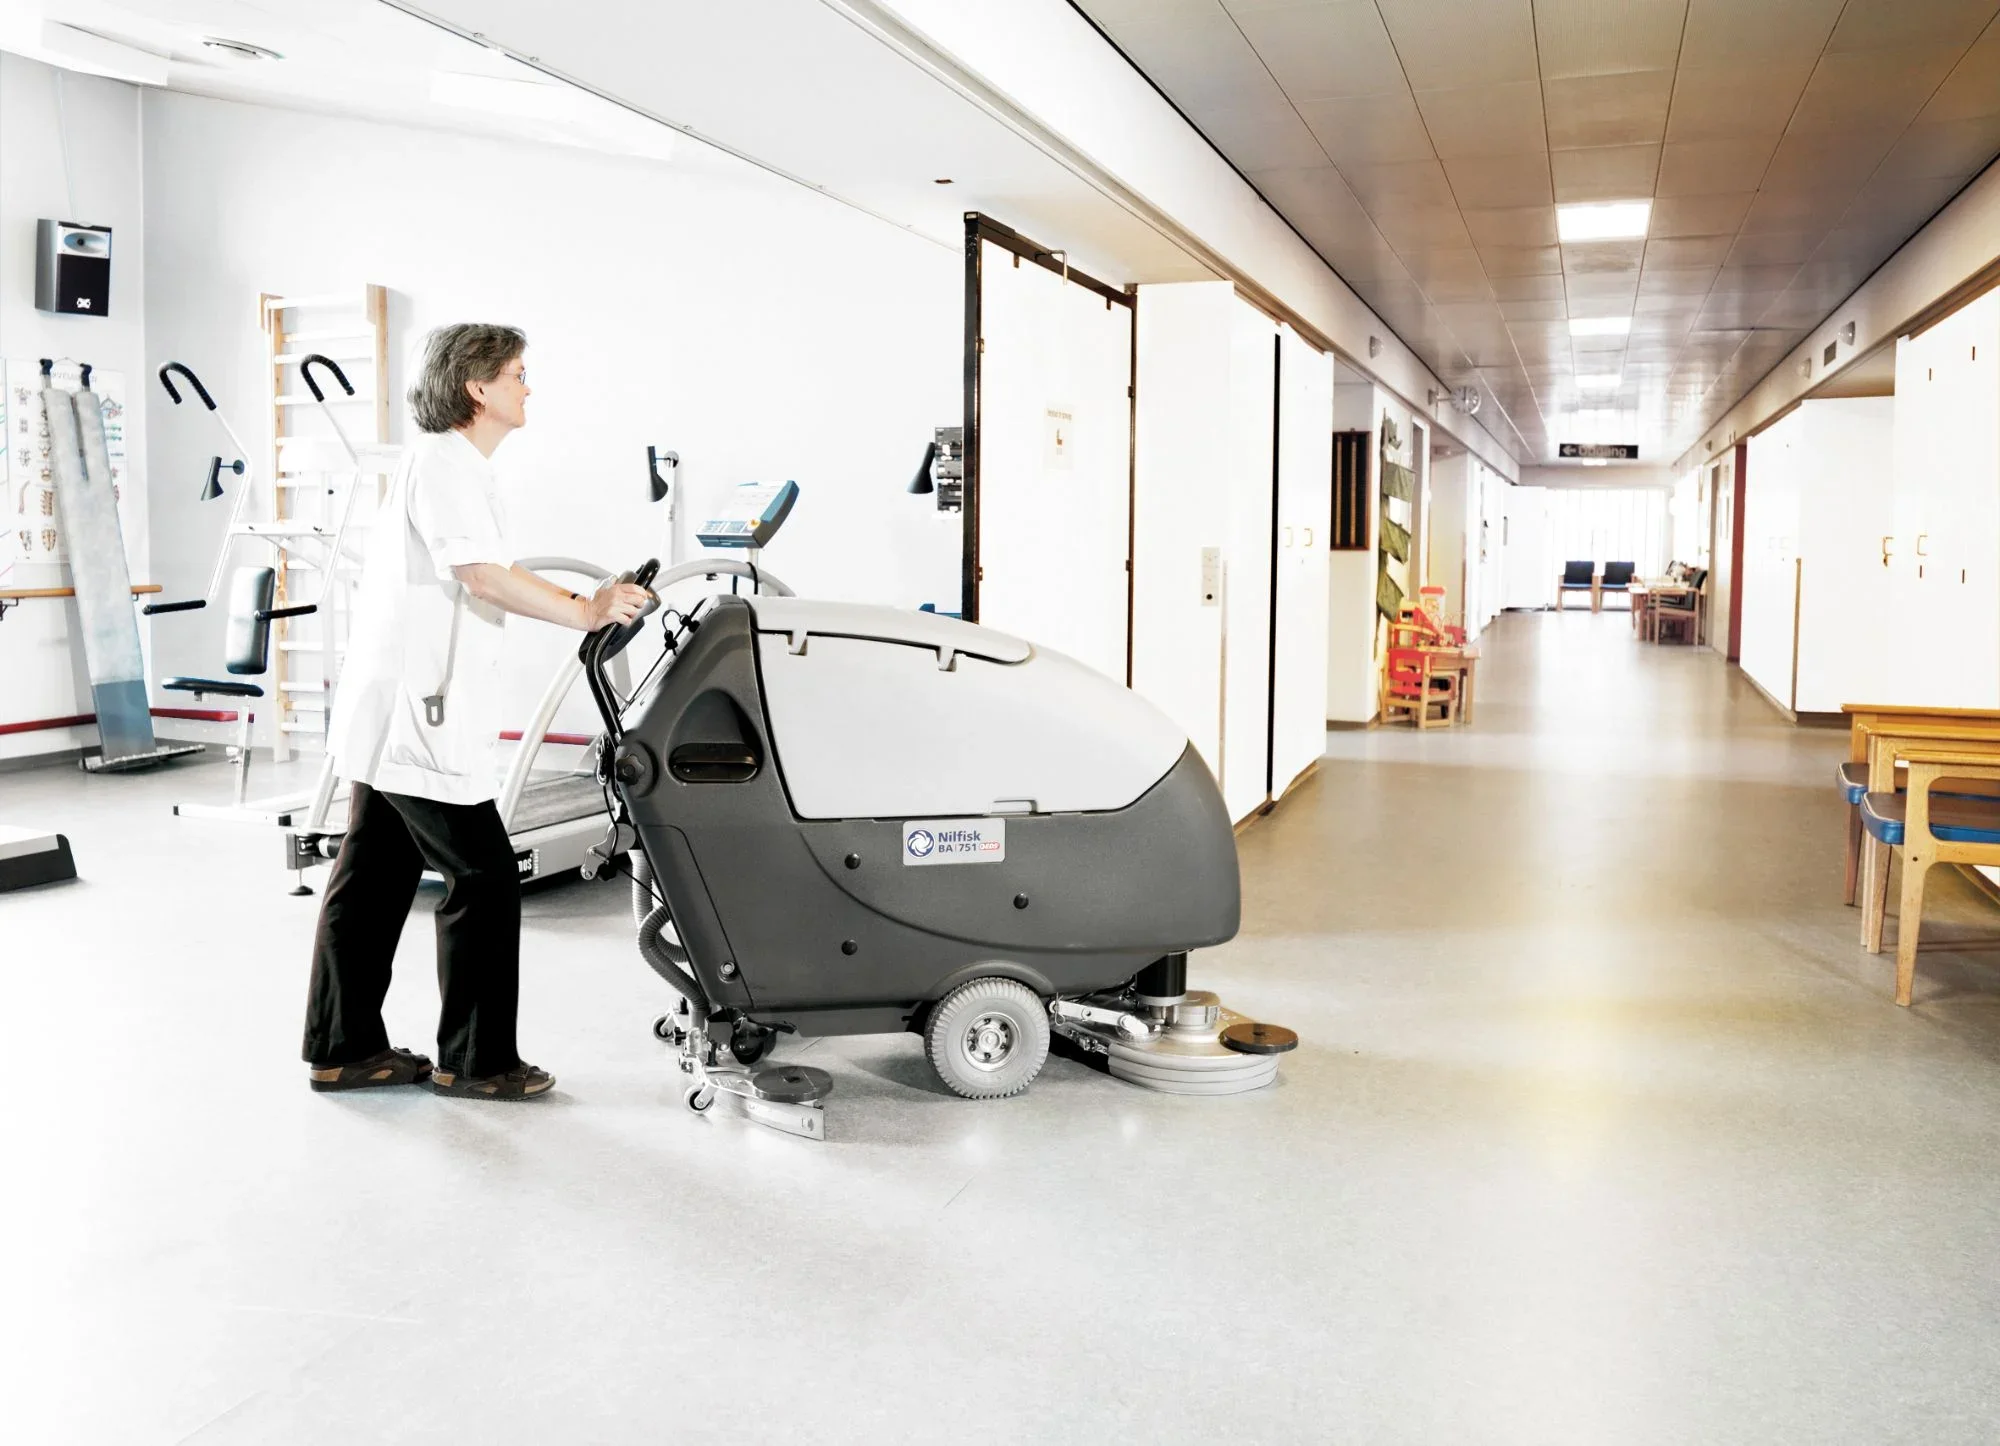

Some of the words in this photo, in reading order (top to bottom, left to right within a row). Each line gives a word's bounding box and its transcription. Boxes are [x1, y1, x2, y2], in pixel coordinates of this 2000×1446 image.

[938, 831, 981, 842] Nilfisk
[939, 845, 953, 853] BA
[960, 843, 977, 852] 751
